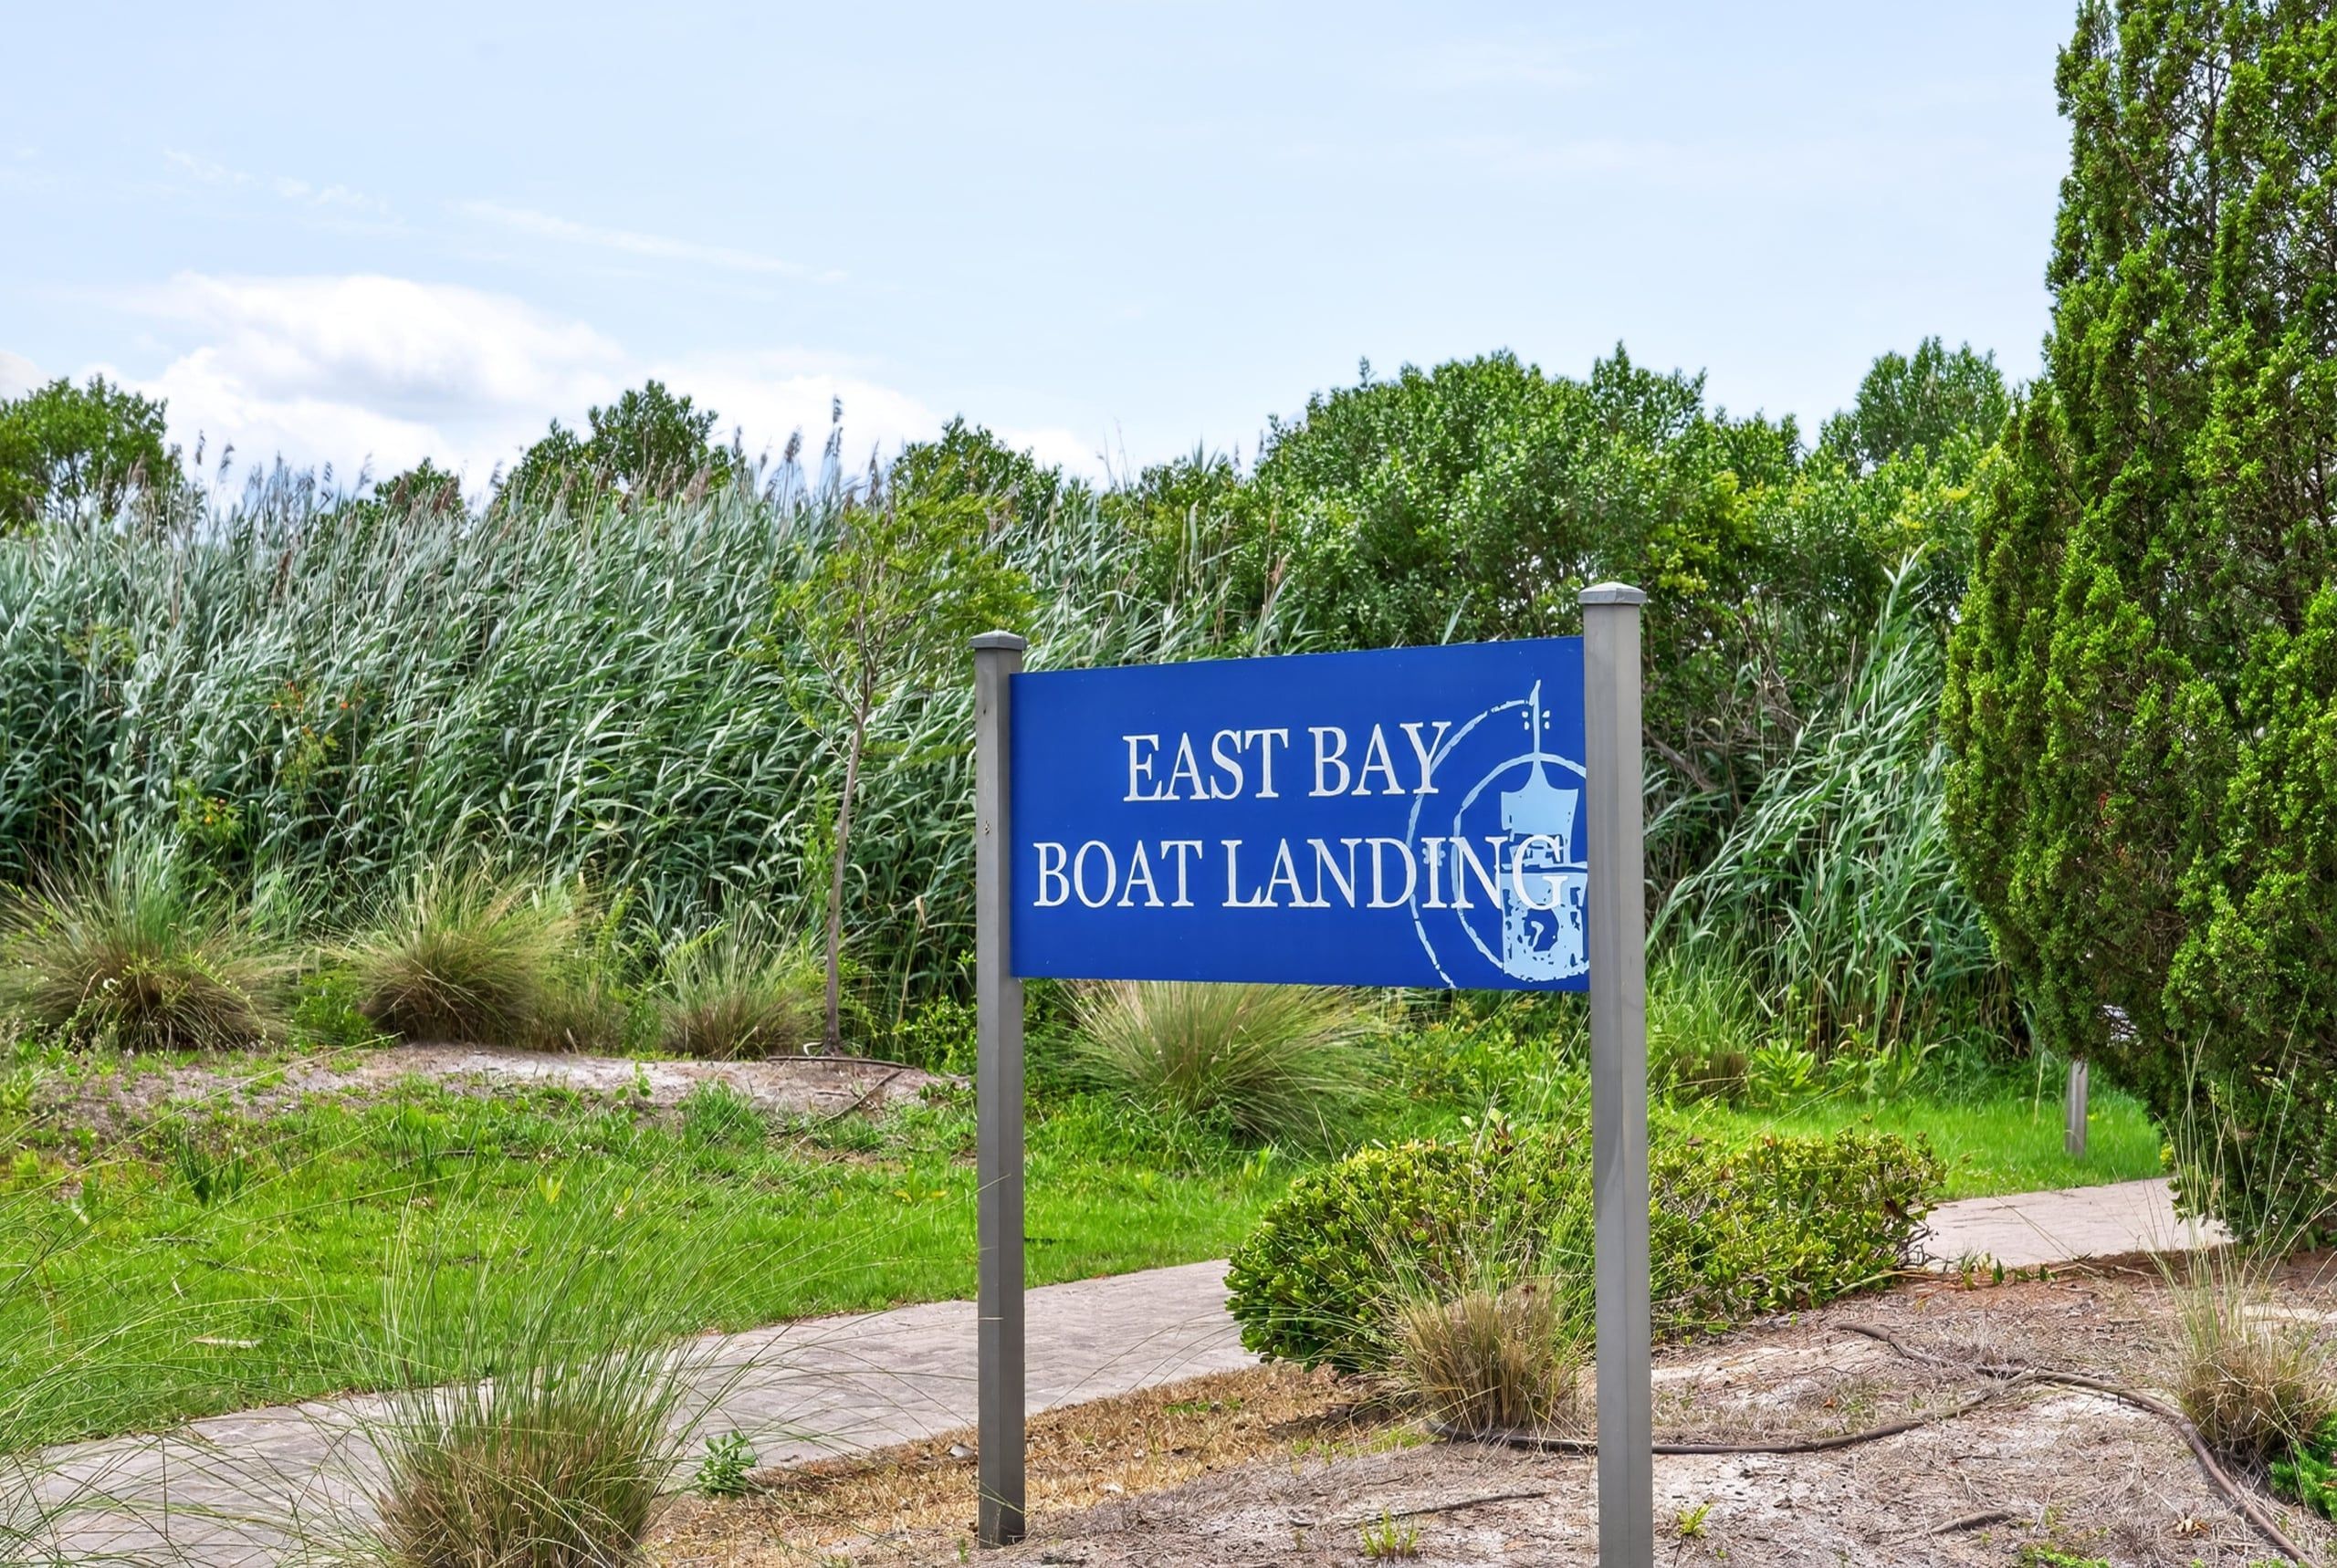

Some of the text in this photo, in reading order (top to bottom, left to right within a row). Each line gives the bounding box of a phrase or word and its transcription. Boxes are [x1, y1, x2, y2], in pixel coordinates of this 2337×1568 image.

[1122, 721, 1451, 802] EAST BAY
[1032, 835, 1568, 911] BOAT LANDING
